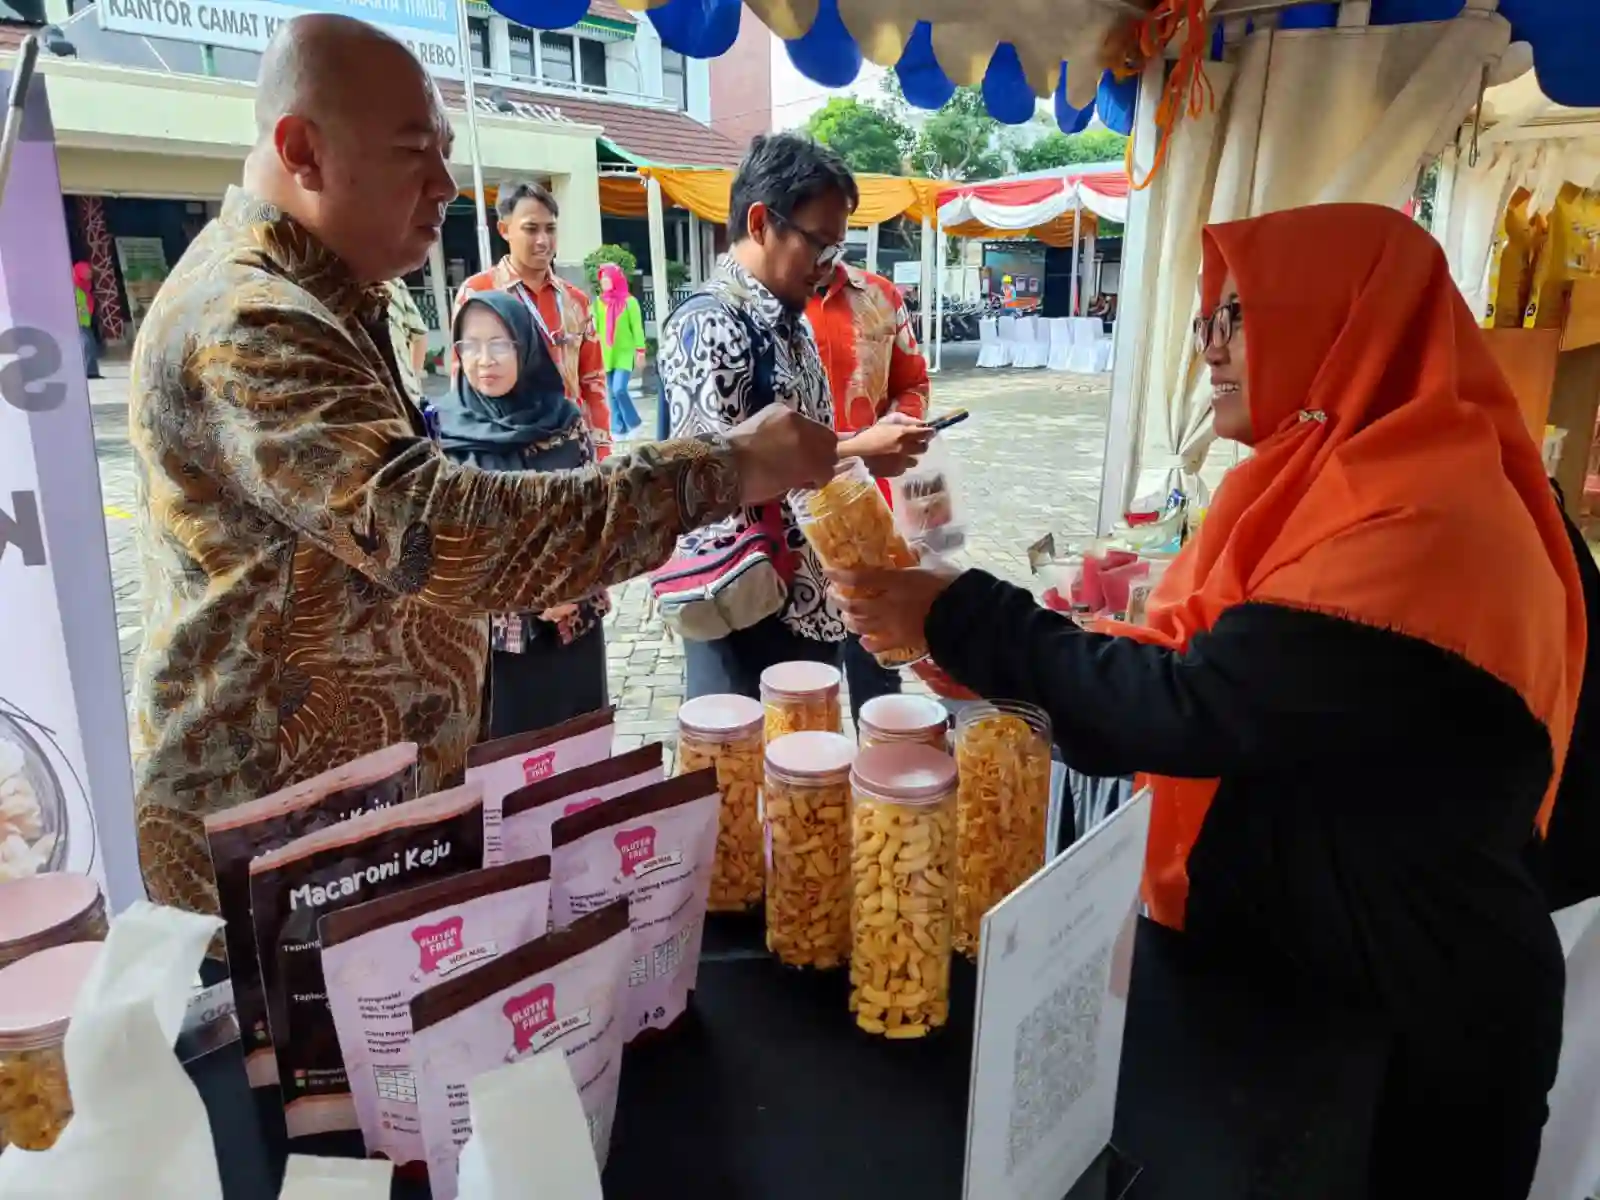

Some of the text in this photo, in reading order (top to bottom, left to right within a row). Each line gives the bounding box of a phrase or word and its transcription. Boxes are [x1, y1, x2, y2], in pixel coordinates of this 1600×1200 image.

[109, 0, 192, 27] KANTOR
[198, 6, 258, 37] CAMAT
[420, 42, 456, 66] REBO
[290, 839, 451, 910] Macaroni Keju
[429, 938, 456, 957] FREE
[511, 998, 549, 1024] GLUTEN
[522, 1011, 549, 1031] FREE
